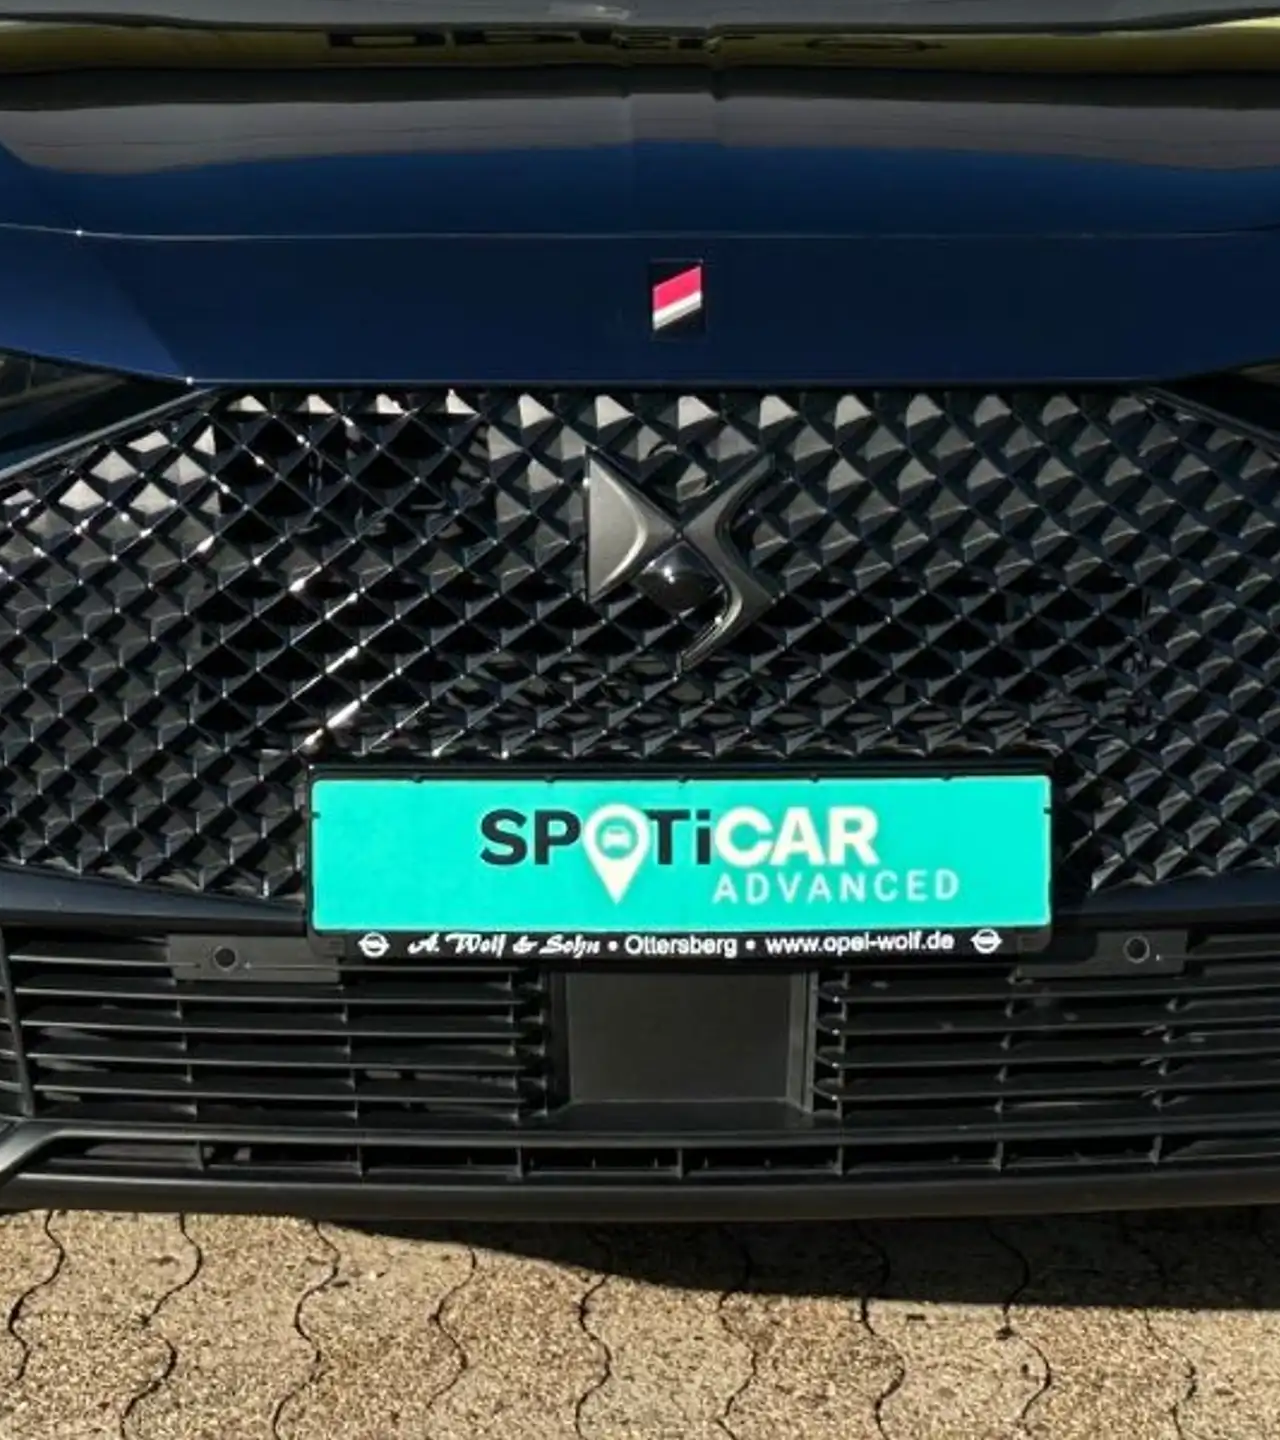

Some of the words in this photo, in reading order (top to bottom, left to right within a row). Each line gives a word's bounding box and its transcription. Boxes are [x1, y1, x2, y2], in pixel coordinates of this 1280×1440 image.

[711, 868, 961, 907] ADVANCED
[445, 932, 505, 959] Wolf
[512, 935, 538, 955] &
[539, 934, 601, 959] Sohn
[624, 933, 738, 959] Ottersberg
[765, 930, 956, 957] www.opel-wolf.de
